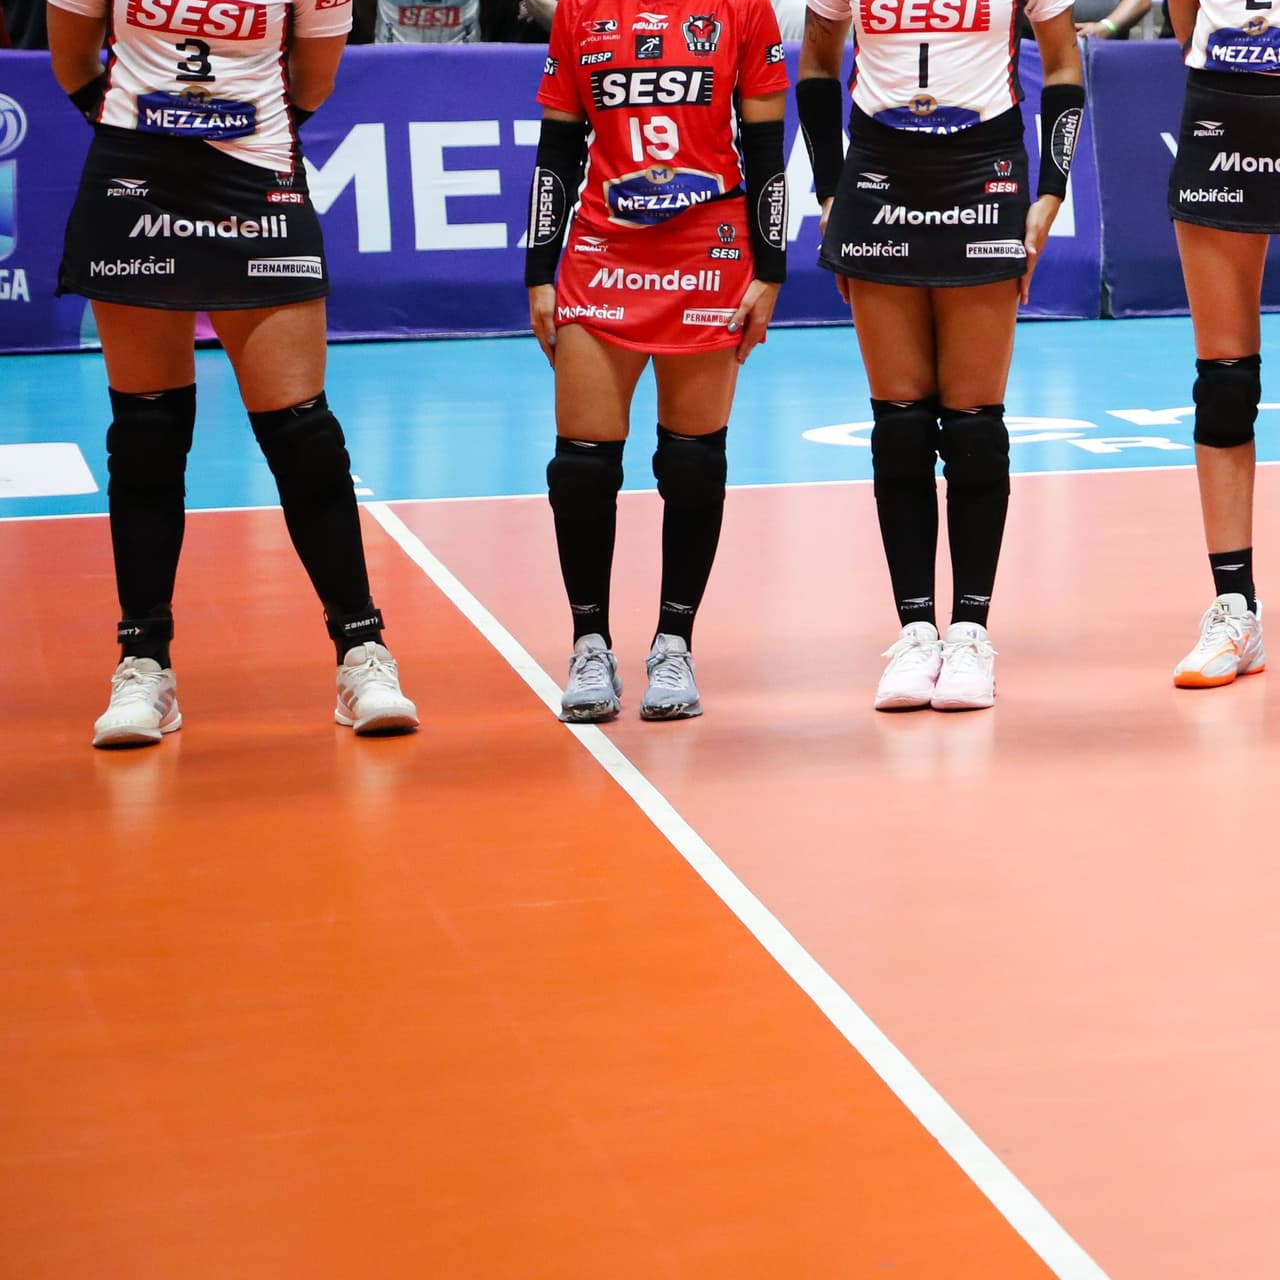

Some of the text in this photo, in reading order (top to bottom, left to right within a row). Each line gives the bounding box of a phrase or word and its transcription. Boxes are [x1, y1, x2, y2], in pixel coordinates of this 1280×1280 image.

[402, 7, 460, 26] SESI
[632, 22, 668, 31] PENALTY
[689, 43, 715, 51] SESI
[176, 39, 215, 74] 3
[582, 52, 611, 64] FIESP
[919, 43, 928, 88] 1
[603, 72, 704, 106] SESI
[146, 110, 248, 129] MEZZANI
[629, 116, 678, 161] 19
[108, 188, 148, 196] PENALTY
[989, 182, 1016, 192] SESI
[1180, 186, 1243, 202] Mobifácil
[271, 193, 300, 202] SESI
[618, 191, 711, 211] MEZZANI
[873, 204, 999, 224] Mondelli
[129, 214, 288, 238] Mondelli
[575, 244, 607, 252] PENALTY
[711, 249, 739, 259] SESI
[842, 240, 908, 257] Mobifácil
[91, 256, 175, 277] Mobifácil
[251, 263, 321, 275] PERNAMBUCANAS
[589, 268, 720, 290] Mondelli
